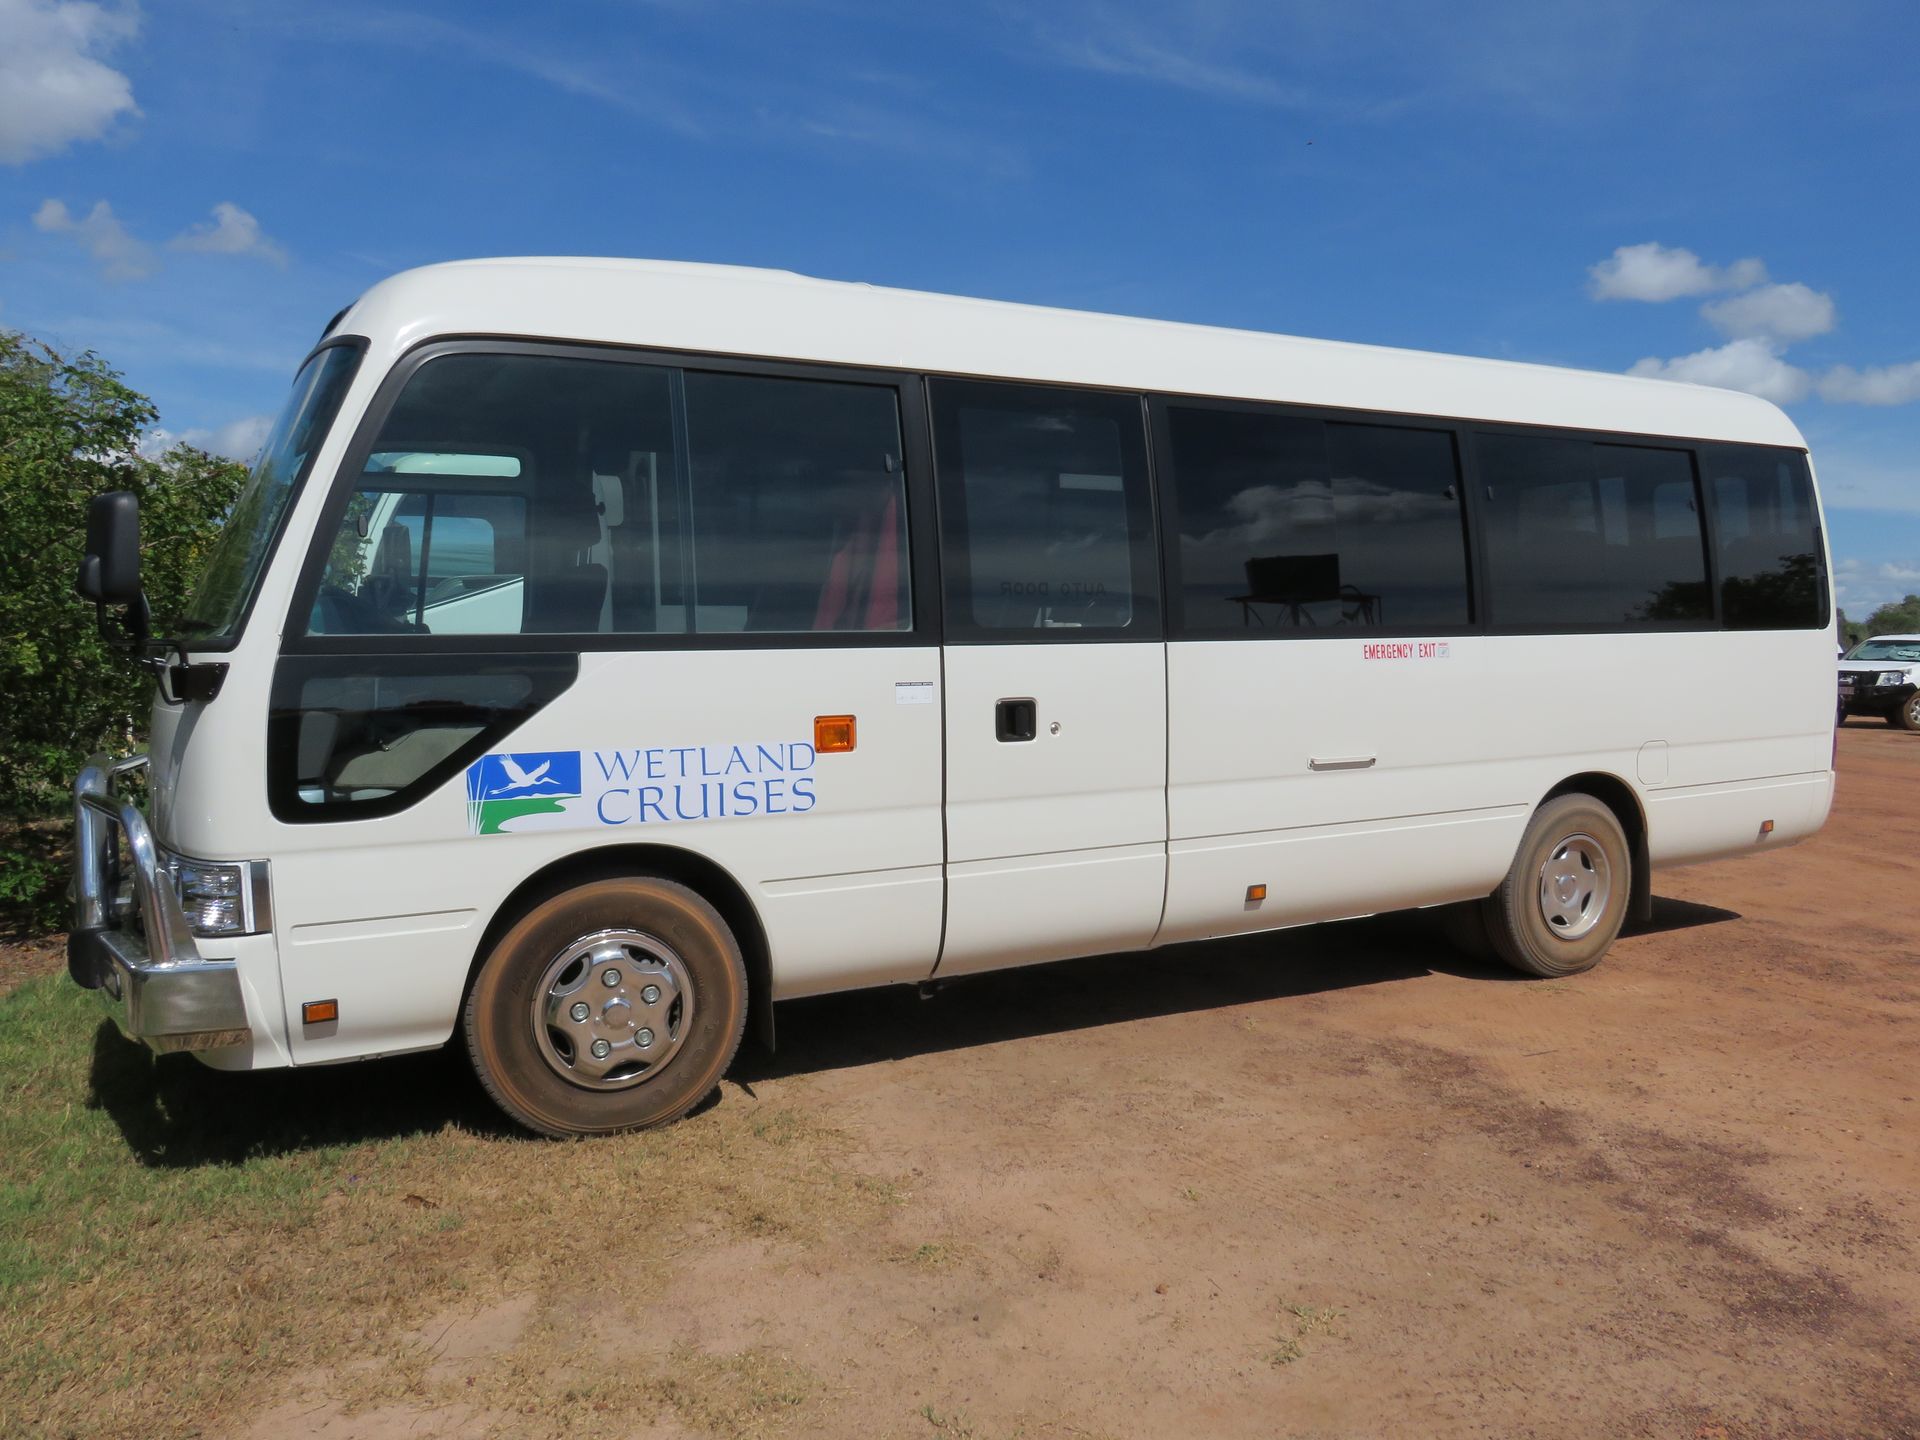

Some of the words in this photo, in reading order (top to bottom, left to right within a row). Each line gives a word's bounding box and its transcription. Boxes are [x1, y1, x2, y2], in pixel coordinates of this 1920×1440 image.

[1363, 643, 1413, 660] EMERGENCY
[1418, 642, 1436, 658] EXIT
[594, 742, 816, 782] WETLAND
[597, 778, 816, 825] CRUISES
